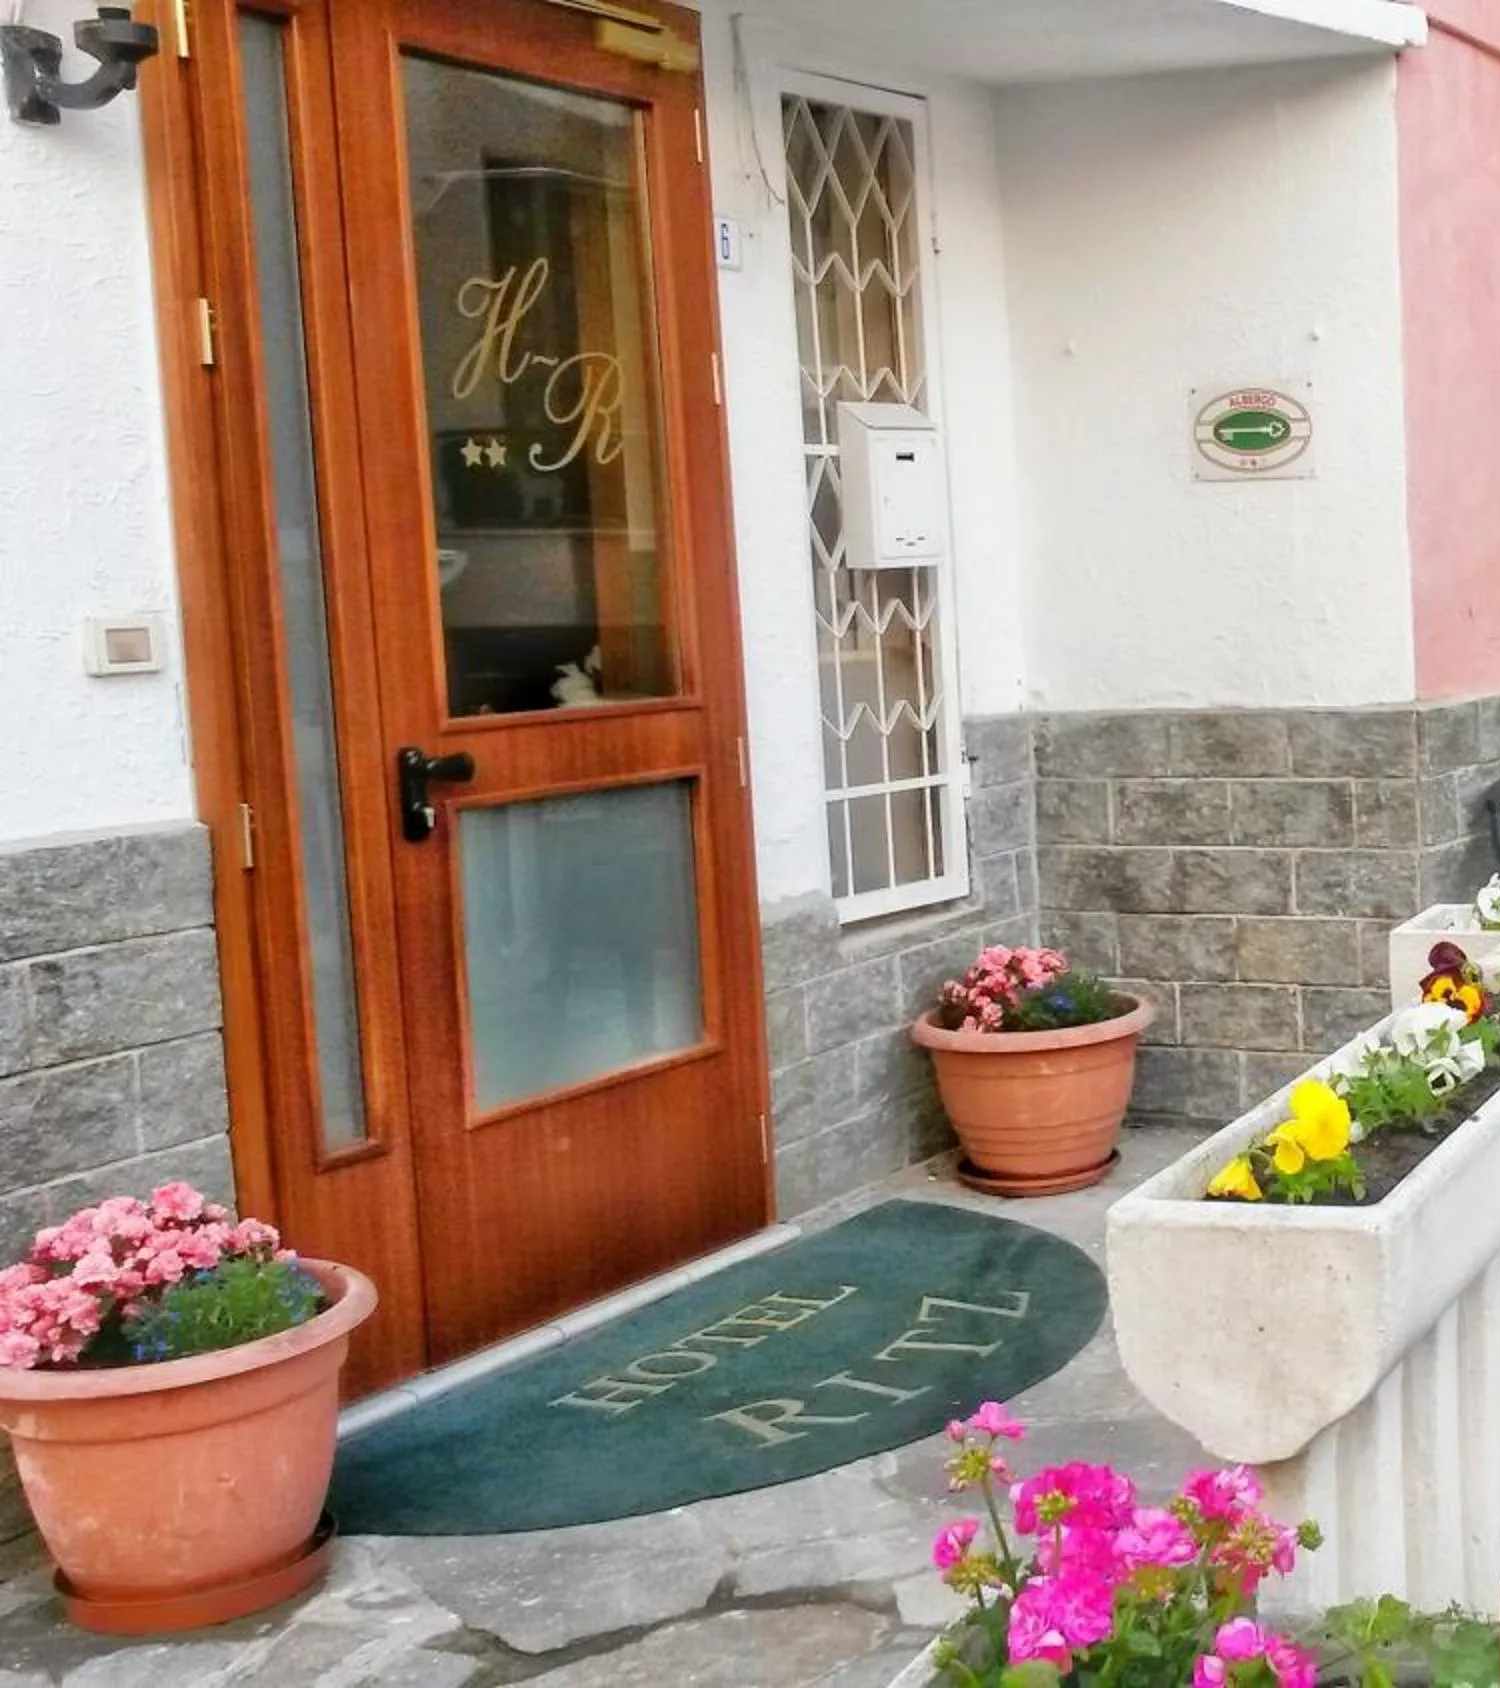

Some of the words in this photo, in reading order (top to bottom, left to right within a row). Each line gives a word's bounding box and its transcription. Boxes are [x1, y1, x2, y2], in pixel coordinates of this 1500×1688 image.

[720, 222, 730, 260] 6
[549, 1284, 859, 1417] HOTEL
[701, 1291, 1031, 1448] RITZ
